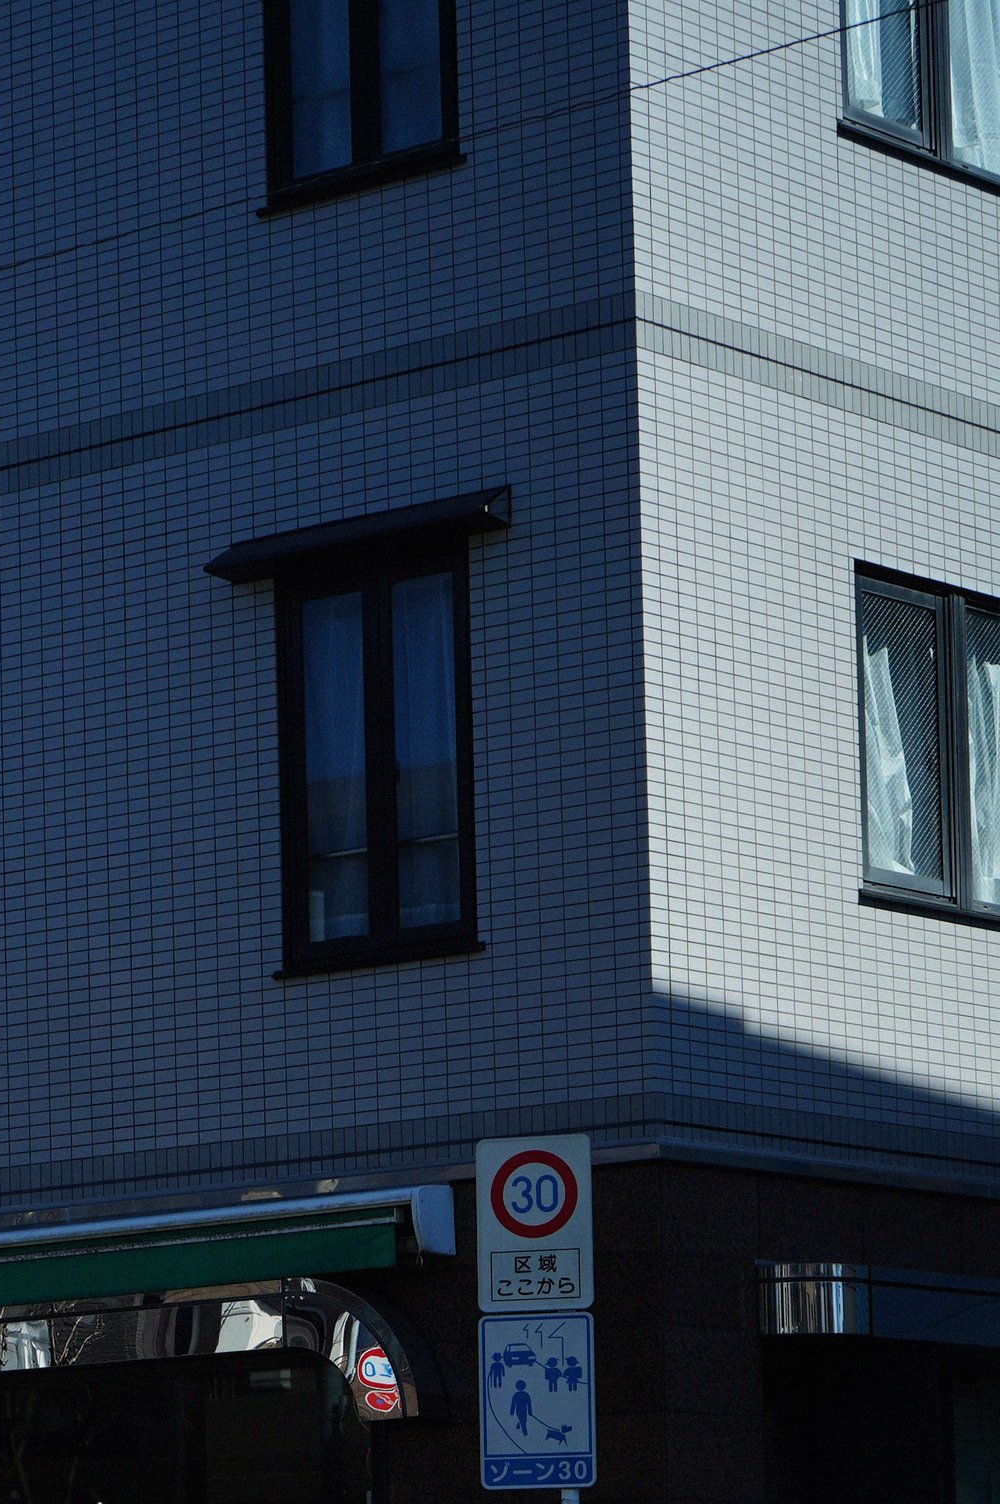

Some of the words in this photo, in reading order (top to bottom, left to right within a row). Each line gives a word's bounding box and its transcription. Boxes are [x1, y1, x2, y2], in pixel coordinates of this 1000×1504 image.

[511, 1174, 559, 1214] 30
[514, 1254, 558, 1274] 区域
[497, 1277, 576, 1297] ここから
[489, 1460, 588, 1483] ゾーン30
